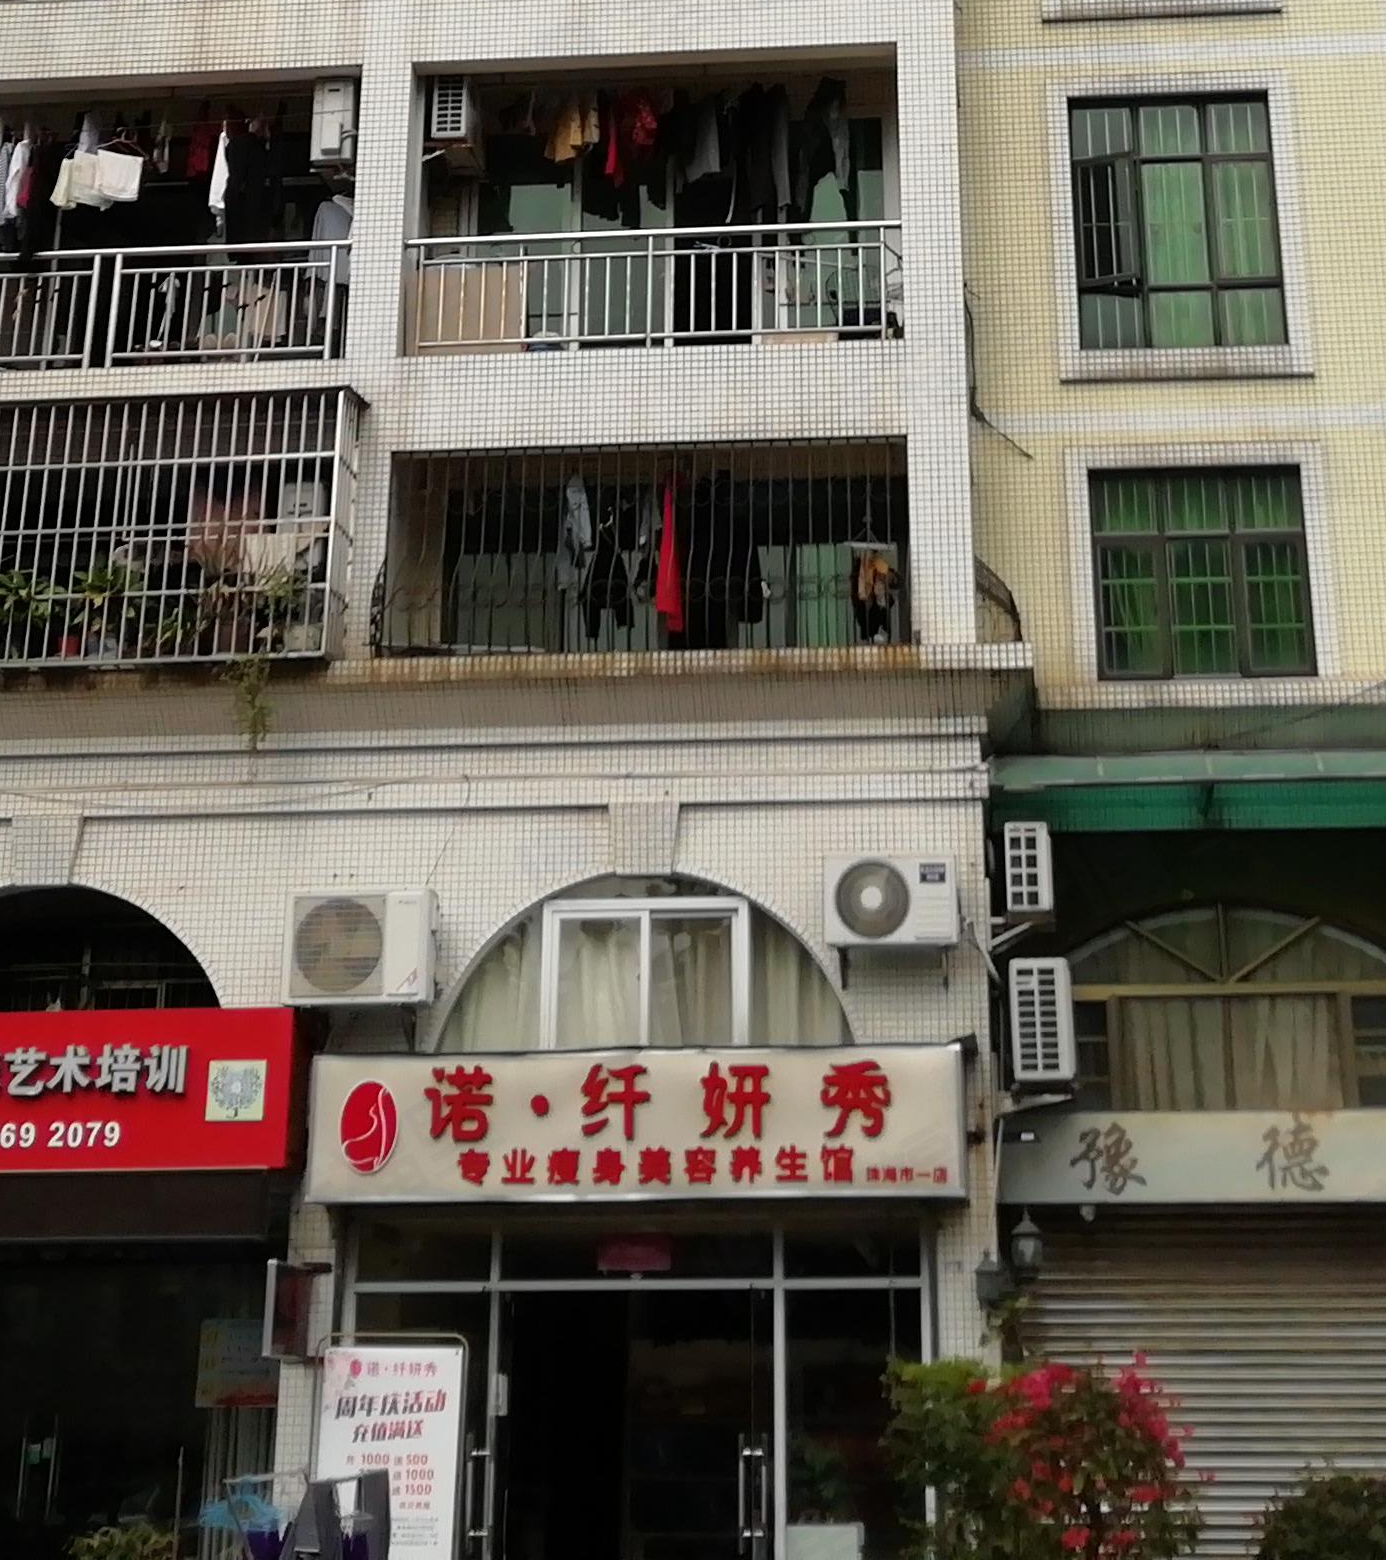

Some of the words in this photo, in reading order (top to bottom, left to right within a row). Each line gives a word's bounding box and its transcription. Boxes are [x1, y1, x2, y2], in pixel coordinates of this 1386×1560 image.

[47, 1121, 121, 1148] 2079
[457, 1146, 855, 1187] 专业瘦身美容养生馆
[335, 1388, 448, 1420] 周年庆活动
[361, 1452, 390, 1466] 1000
[406, 1453, 429, 1466] 500
[405, 1468, 435, 1481] 1000
